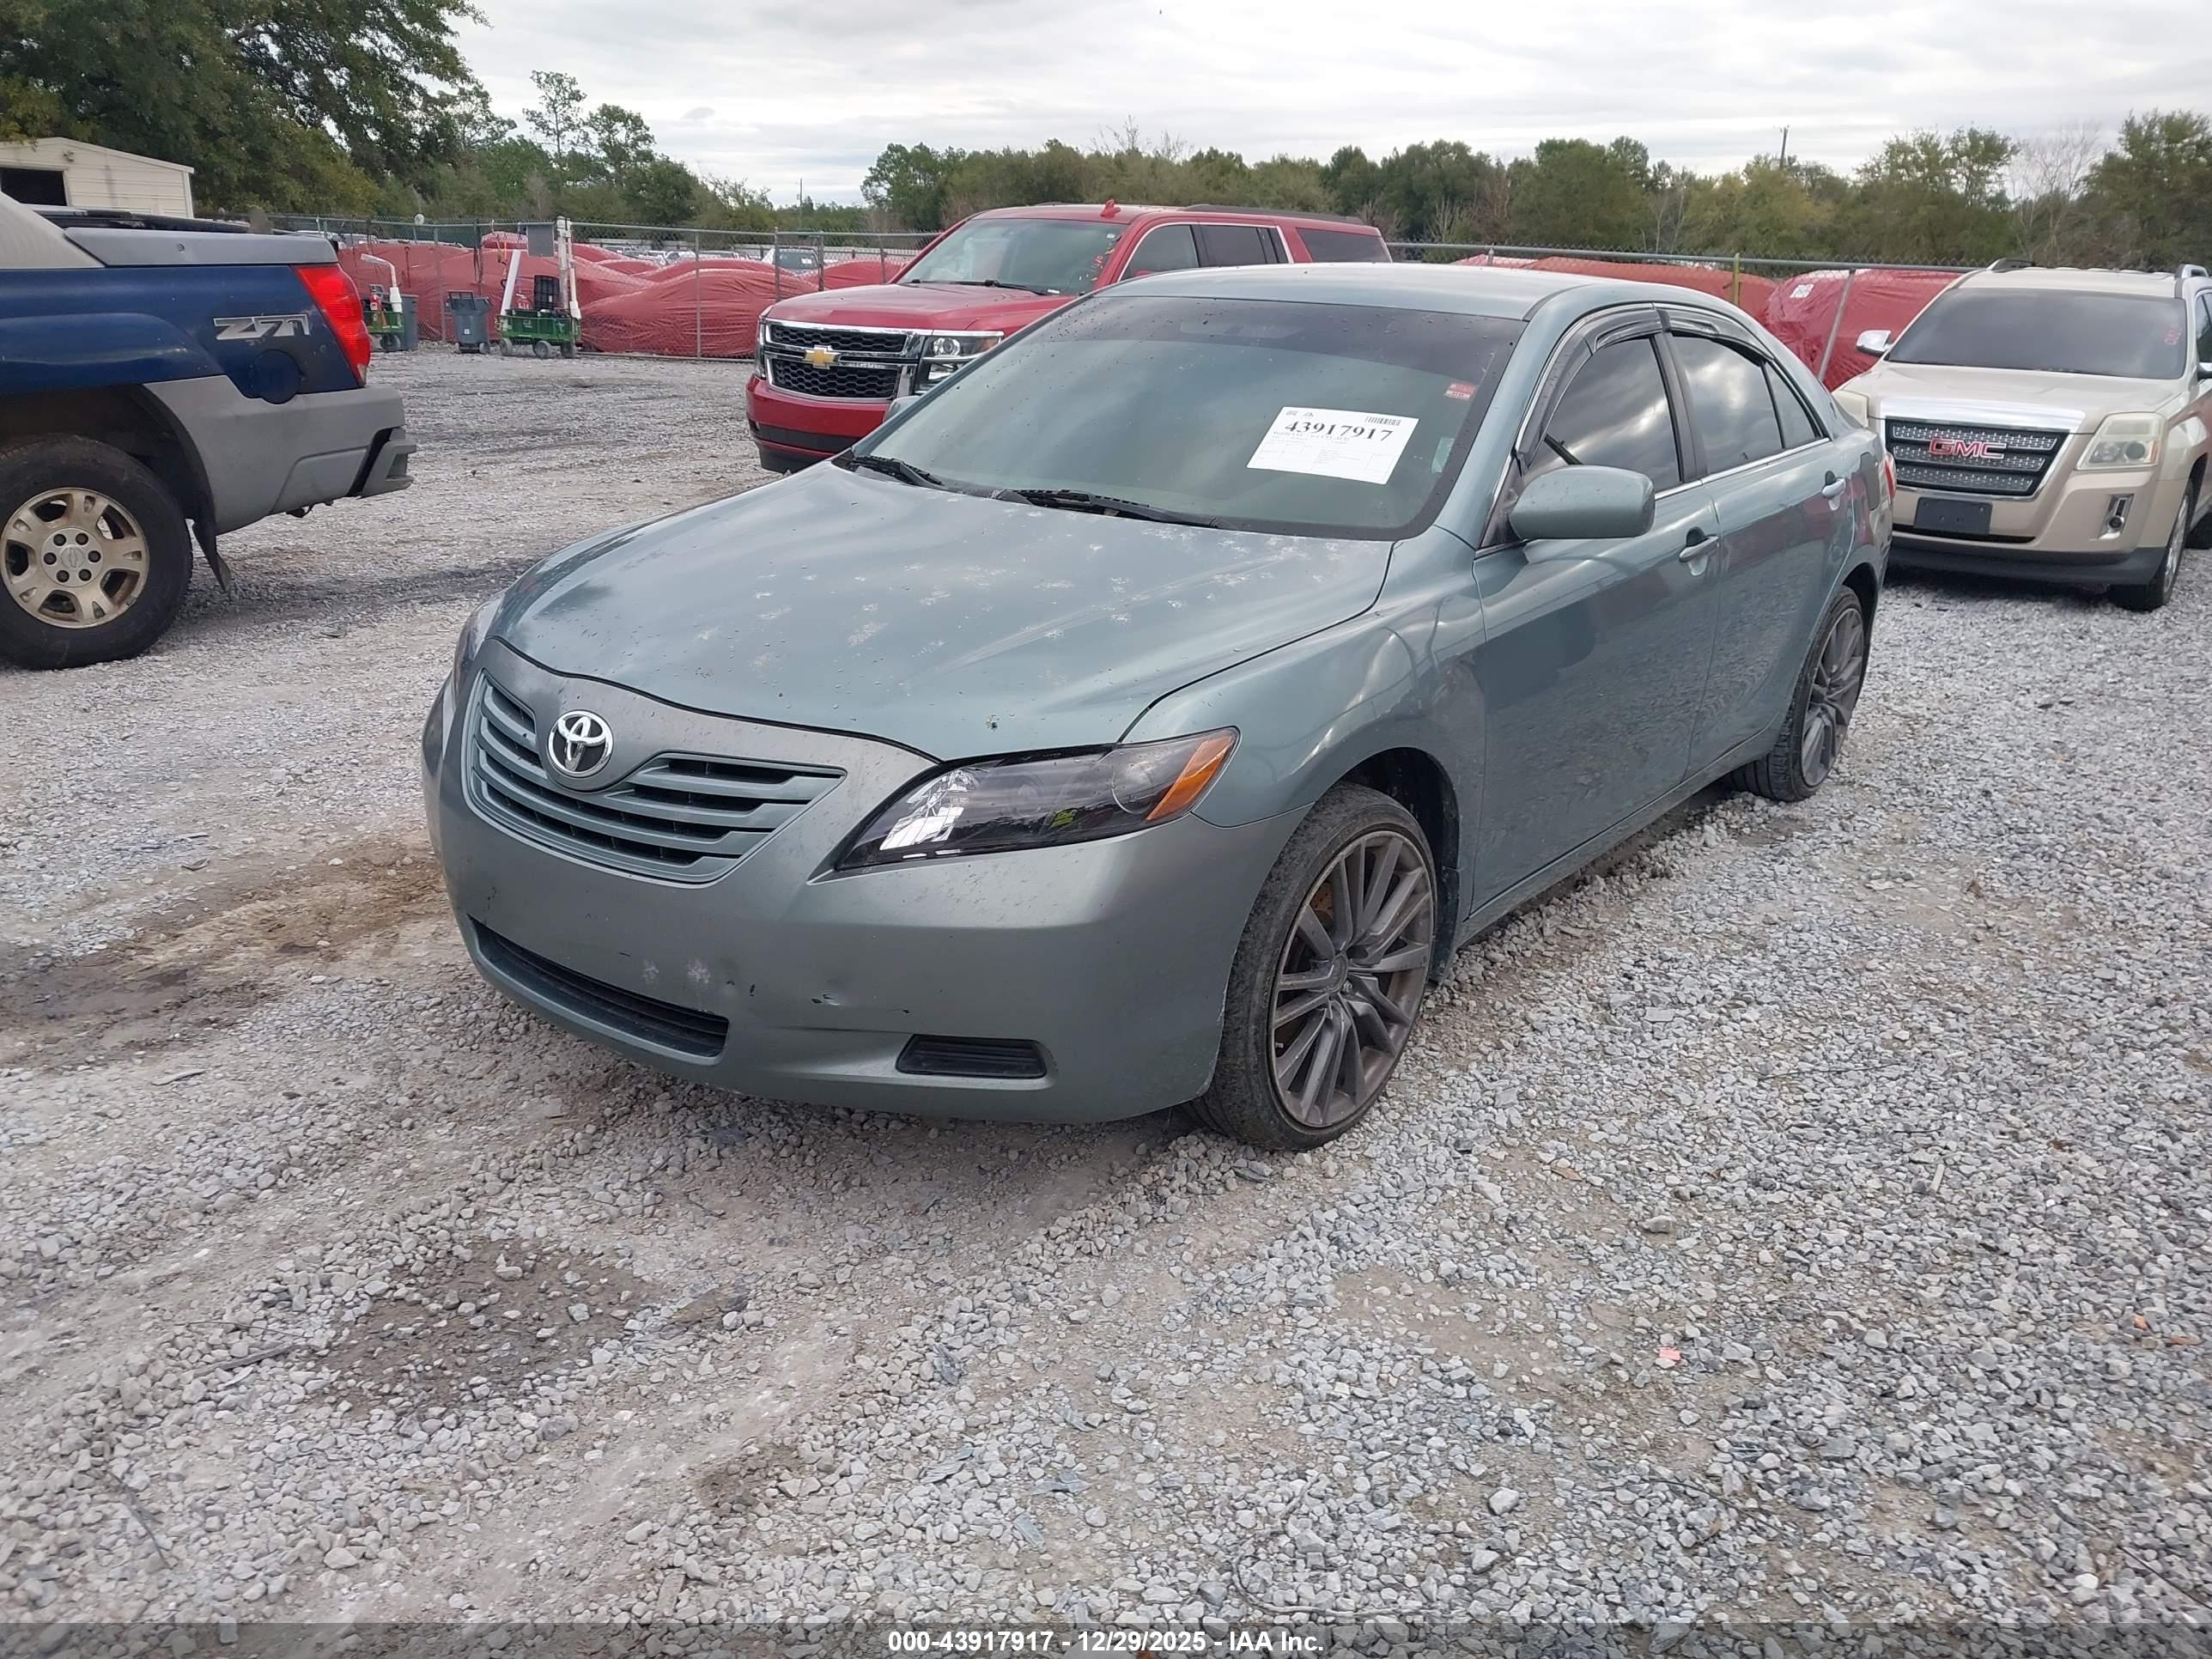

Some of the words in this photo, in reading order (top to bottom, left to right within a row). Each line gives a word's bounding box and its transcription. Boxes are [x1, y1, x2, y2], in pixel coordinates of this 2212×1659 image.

[213, 313, 310, 340] Z71
[1285, 421, 1394, 441] 43917917
[1929, 438, 2007, 459] GMC
